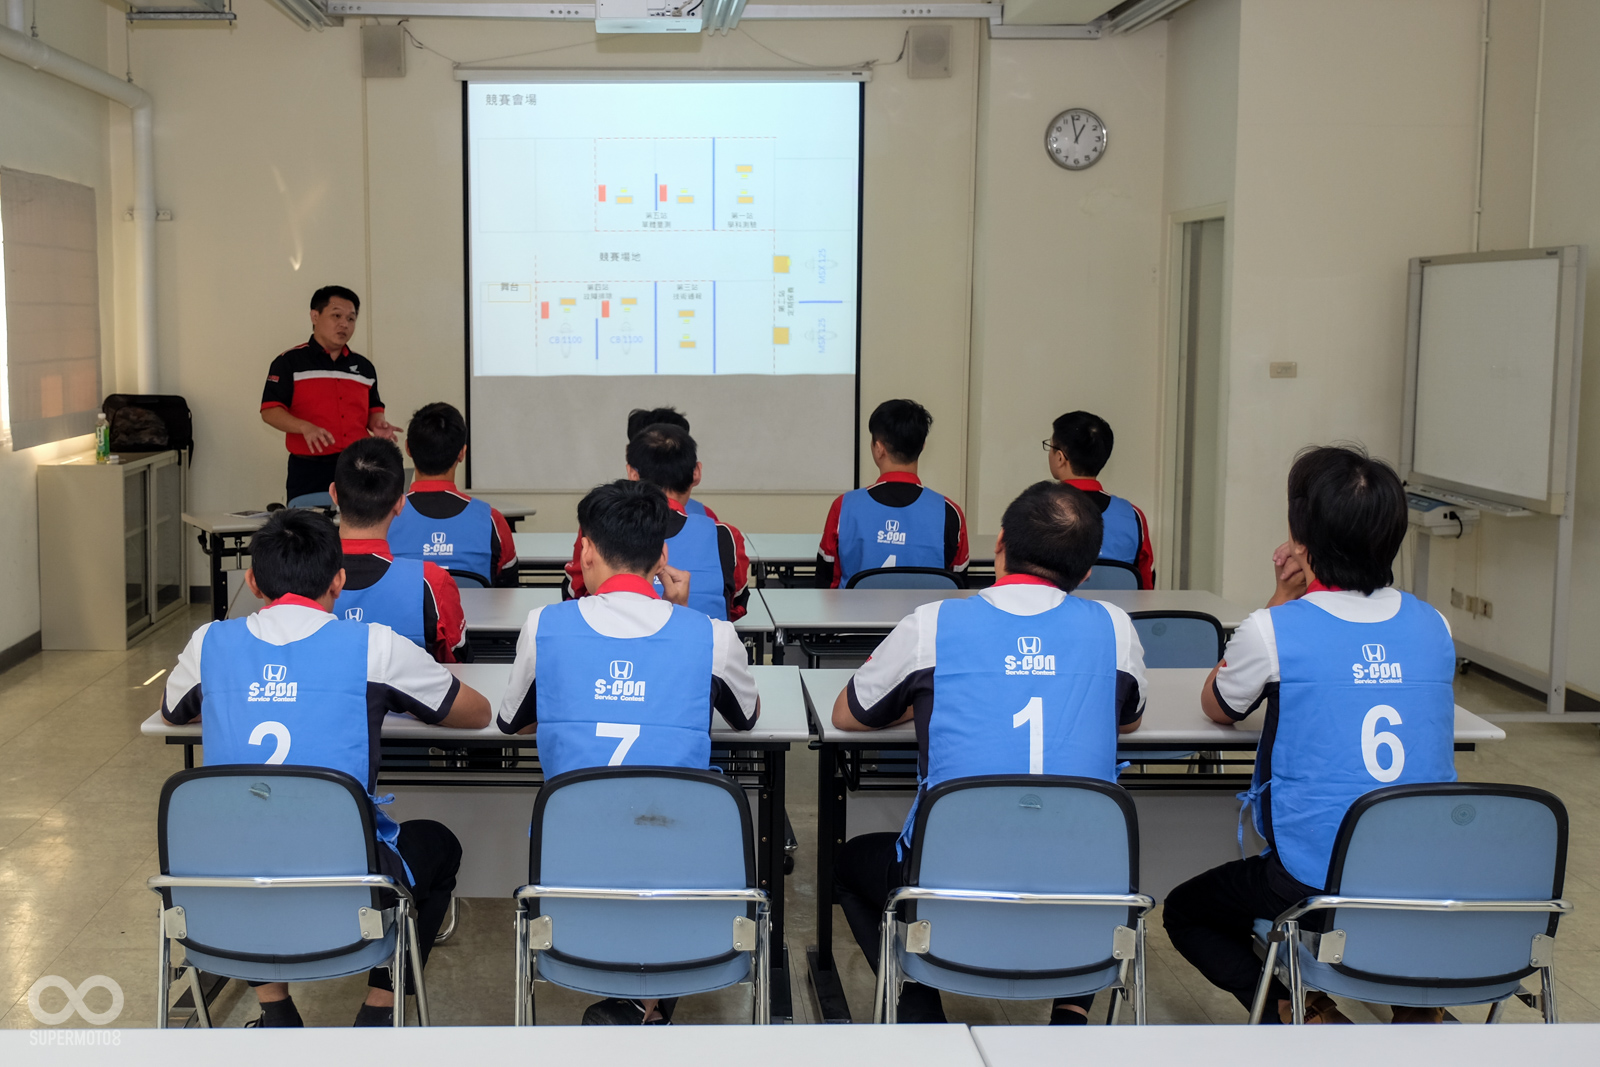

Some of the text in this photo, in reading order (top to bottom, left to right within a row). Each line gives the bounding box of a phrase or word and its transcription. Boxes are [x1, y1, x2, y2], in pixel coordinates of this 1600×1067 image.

[485, 93, 537, 107] 競賽會場
[599, 251, 641, 262] 競賽場地
[548, 335, 583, 344] CB 1100
[609, 335, 644, 344] CB 1100
[248, 720, 292, 765] 2
[595, 722, 641, 766] 7
[1012, 696, 1044, 774] 1
[1361, 704, 1406, 783] 6
